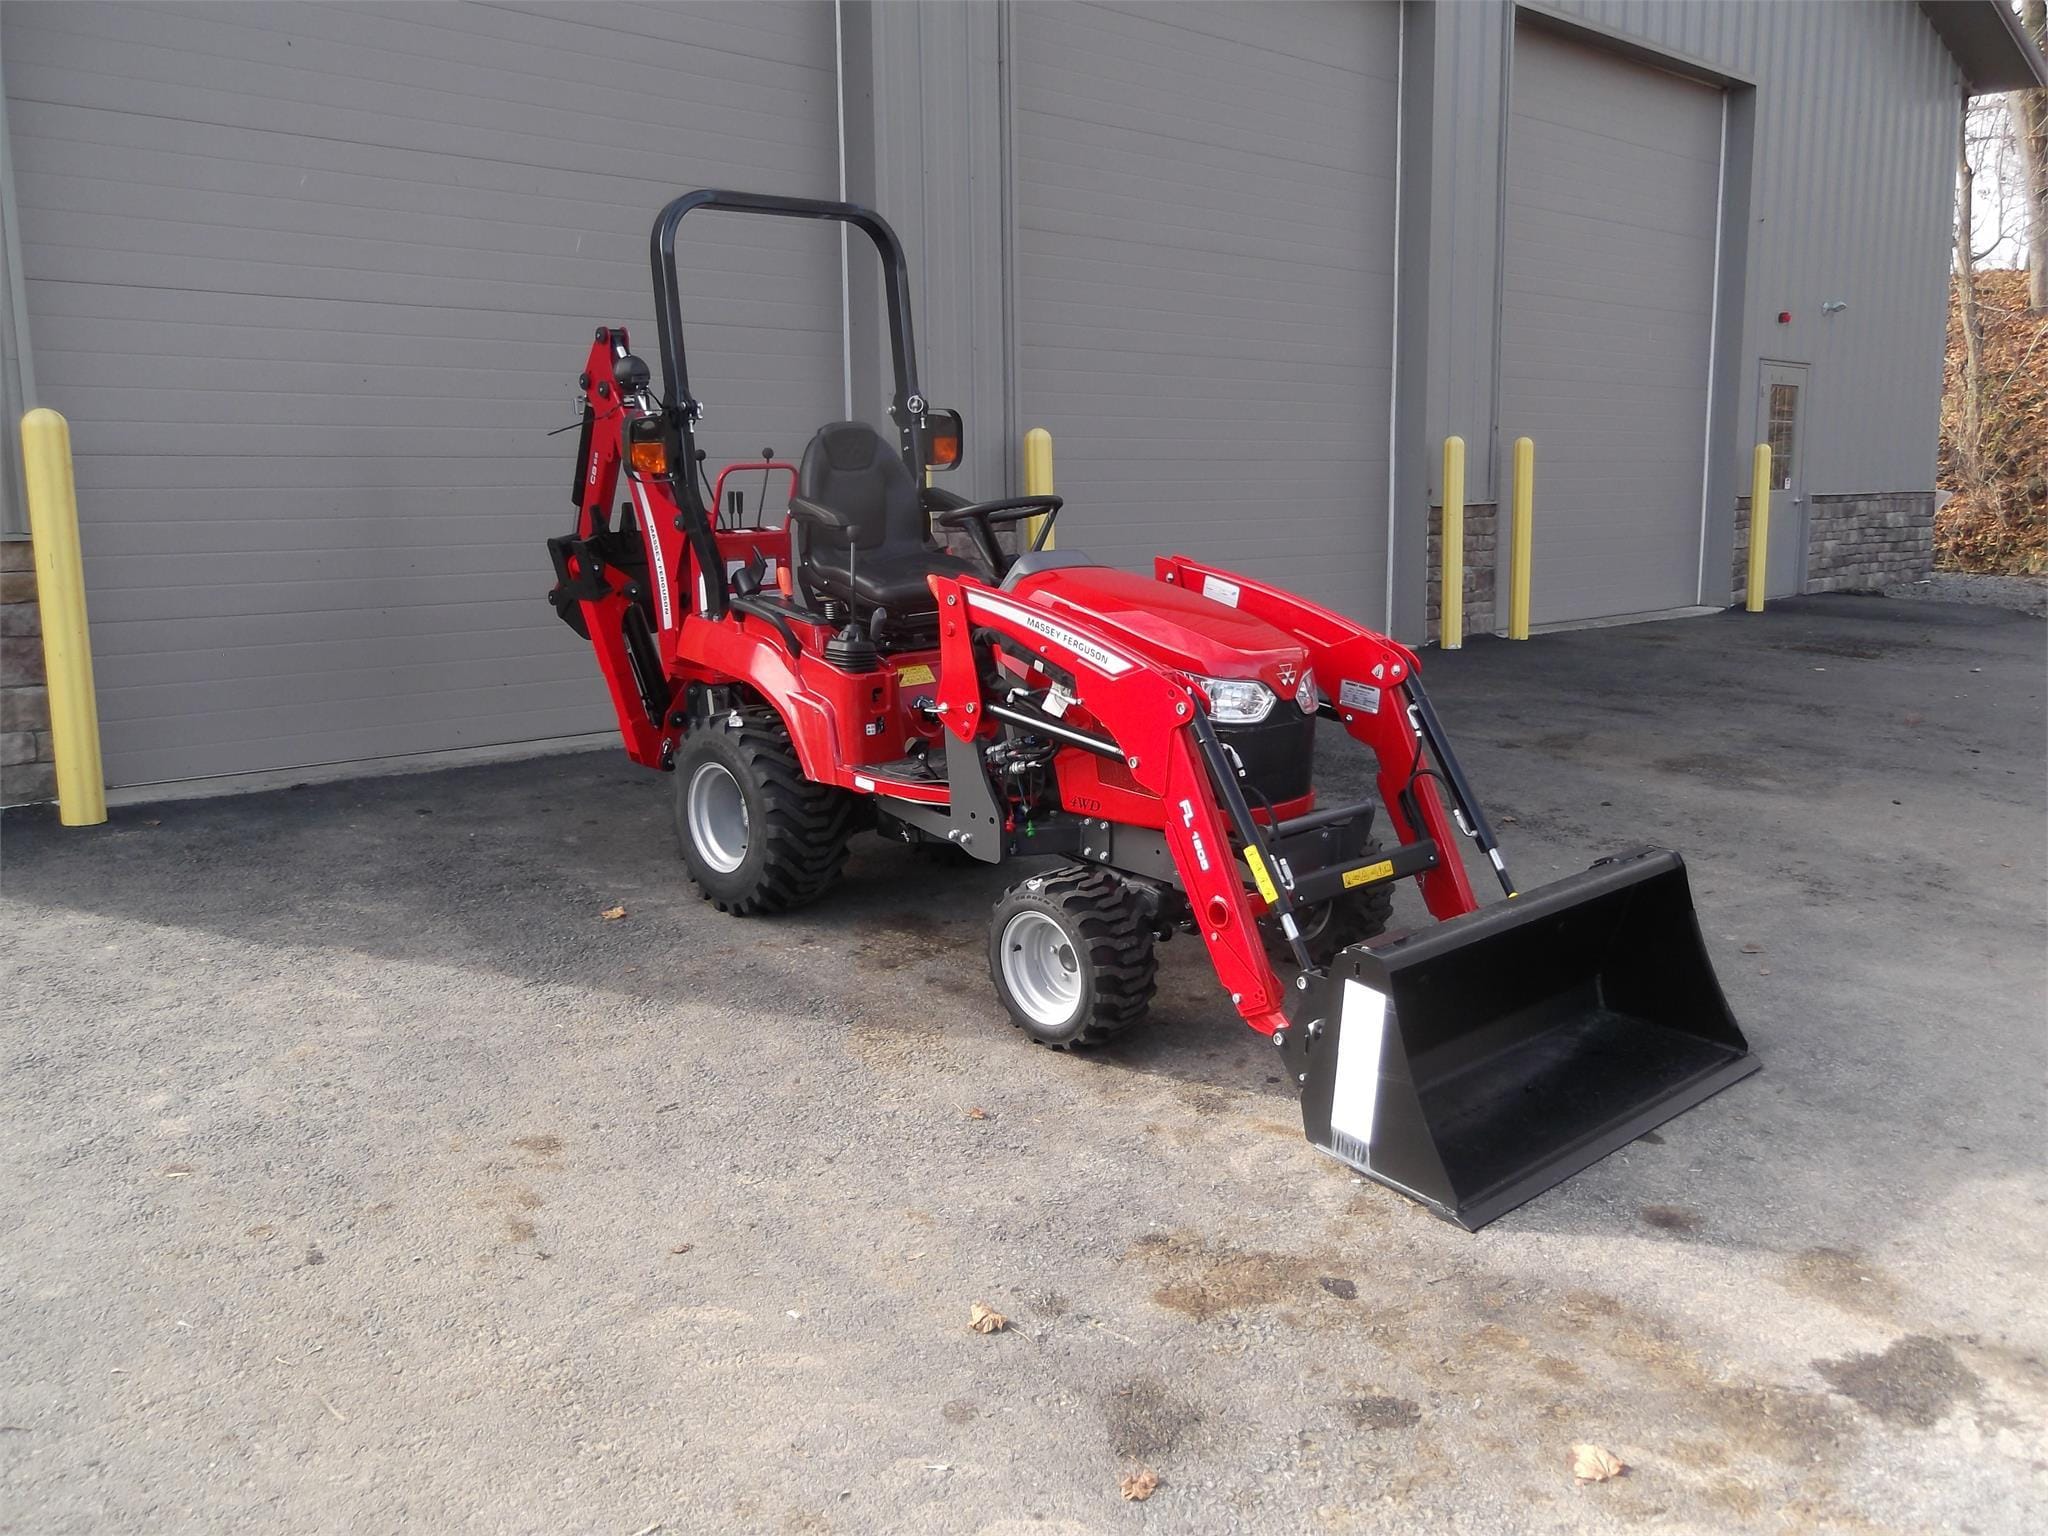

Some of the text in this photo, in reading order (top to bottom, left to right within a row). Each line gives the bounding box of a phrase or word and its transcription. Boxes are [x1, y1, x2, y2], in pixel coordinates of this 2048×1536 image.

[649, 525, 669, 615] MASSEY FERGUSON
[1026, 617, 1108, 665] MASSEY FERGUSON
[1071, 796, 1101, 811] 4WD
